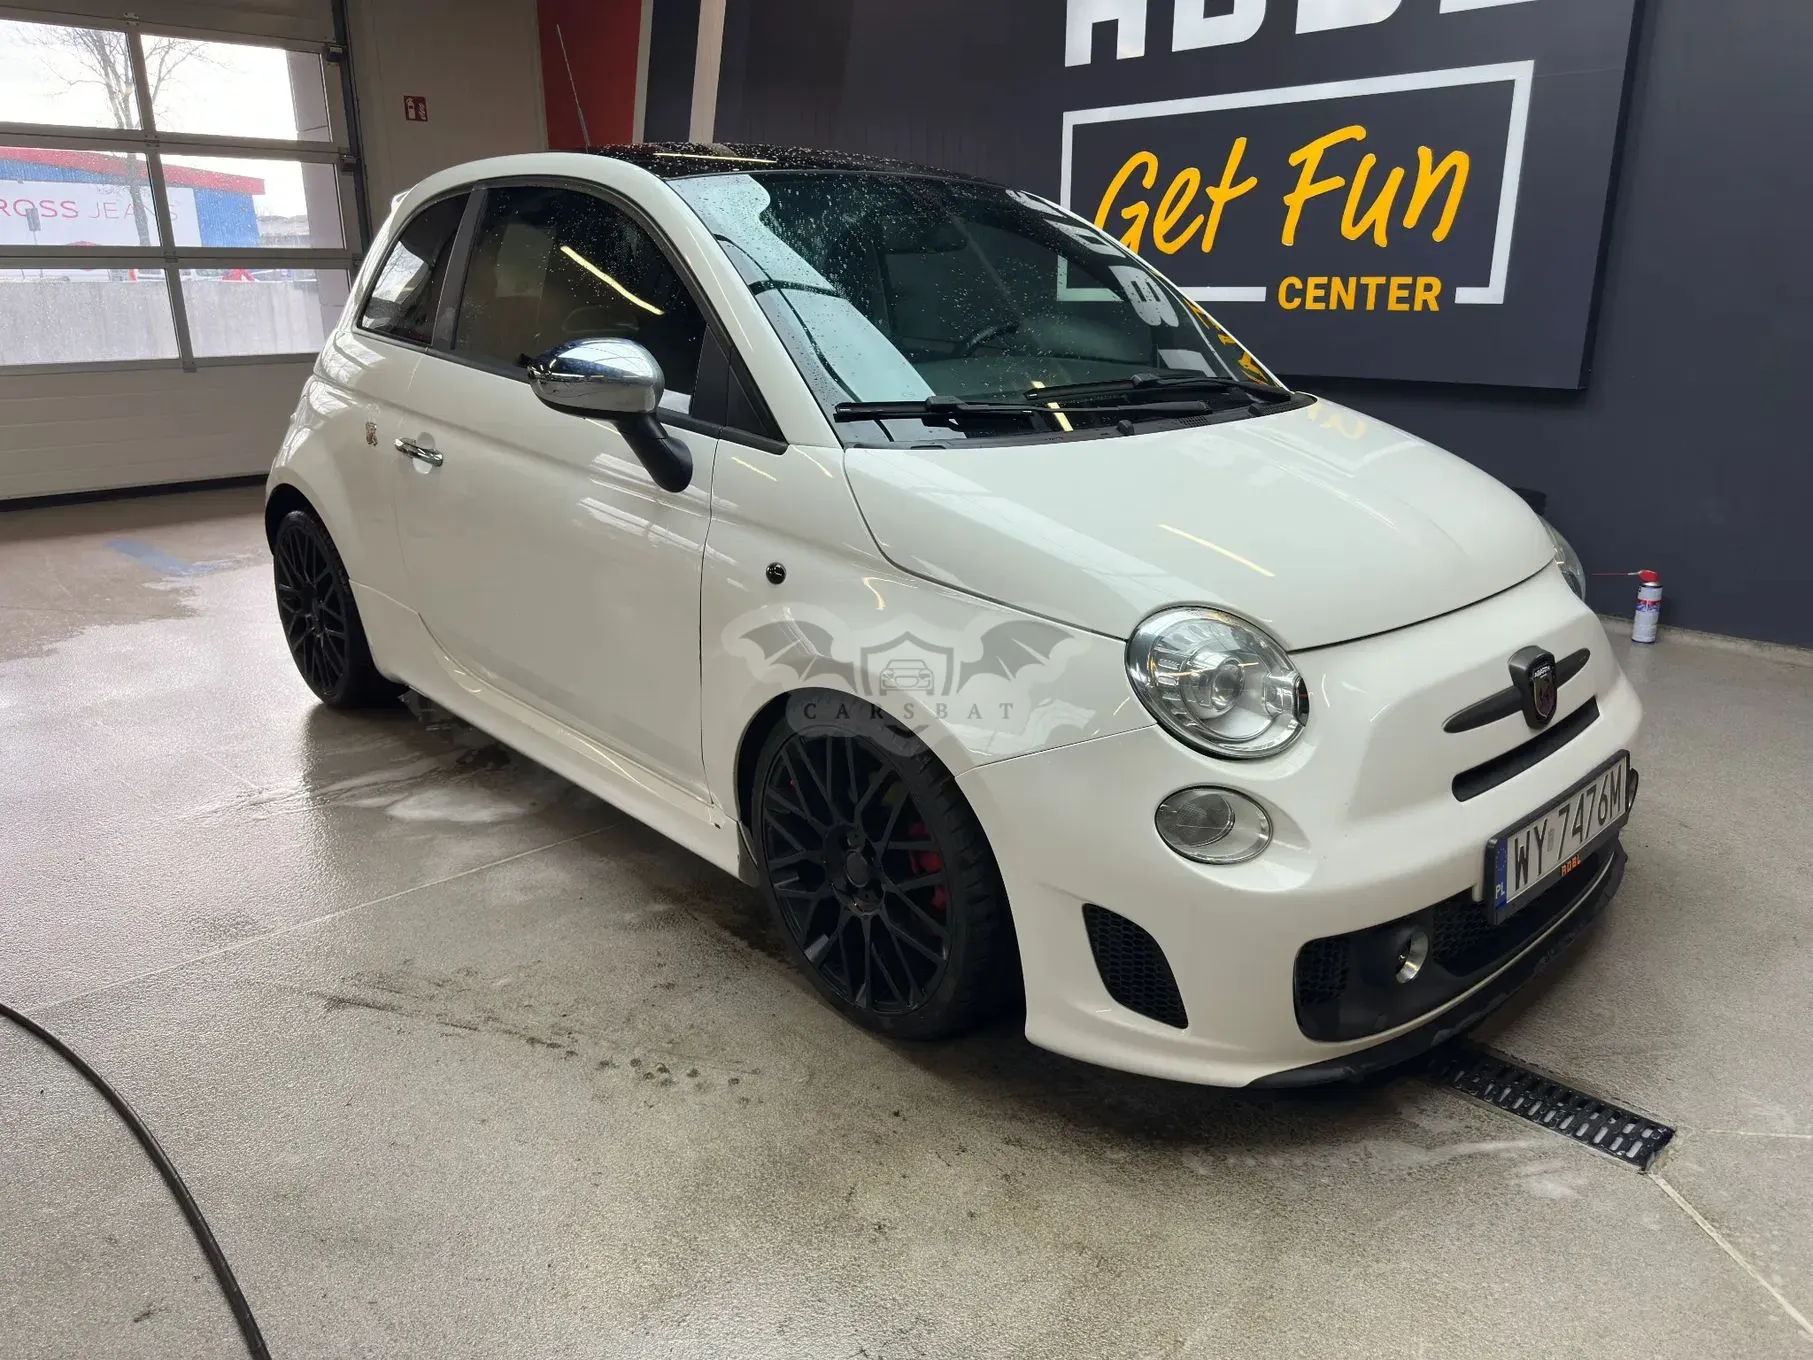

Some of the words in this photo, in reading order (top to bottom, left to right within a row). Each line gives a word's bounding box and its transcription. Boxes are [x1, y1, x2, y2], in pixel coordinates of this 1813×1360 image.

[1094, 136, 1258, 255] Get
[1282, 125, 1470, 247] Fun
[1277, 276, 1442, 312] CENTER
[1514, 818, 1548, 891] WY
[1557, 764, 1622, 861] 7476M
[1495, 881, 1506, 900] PL
